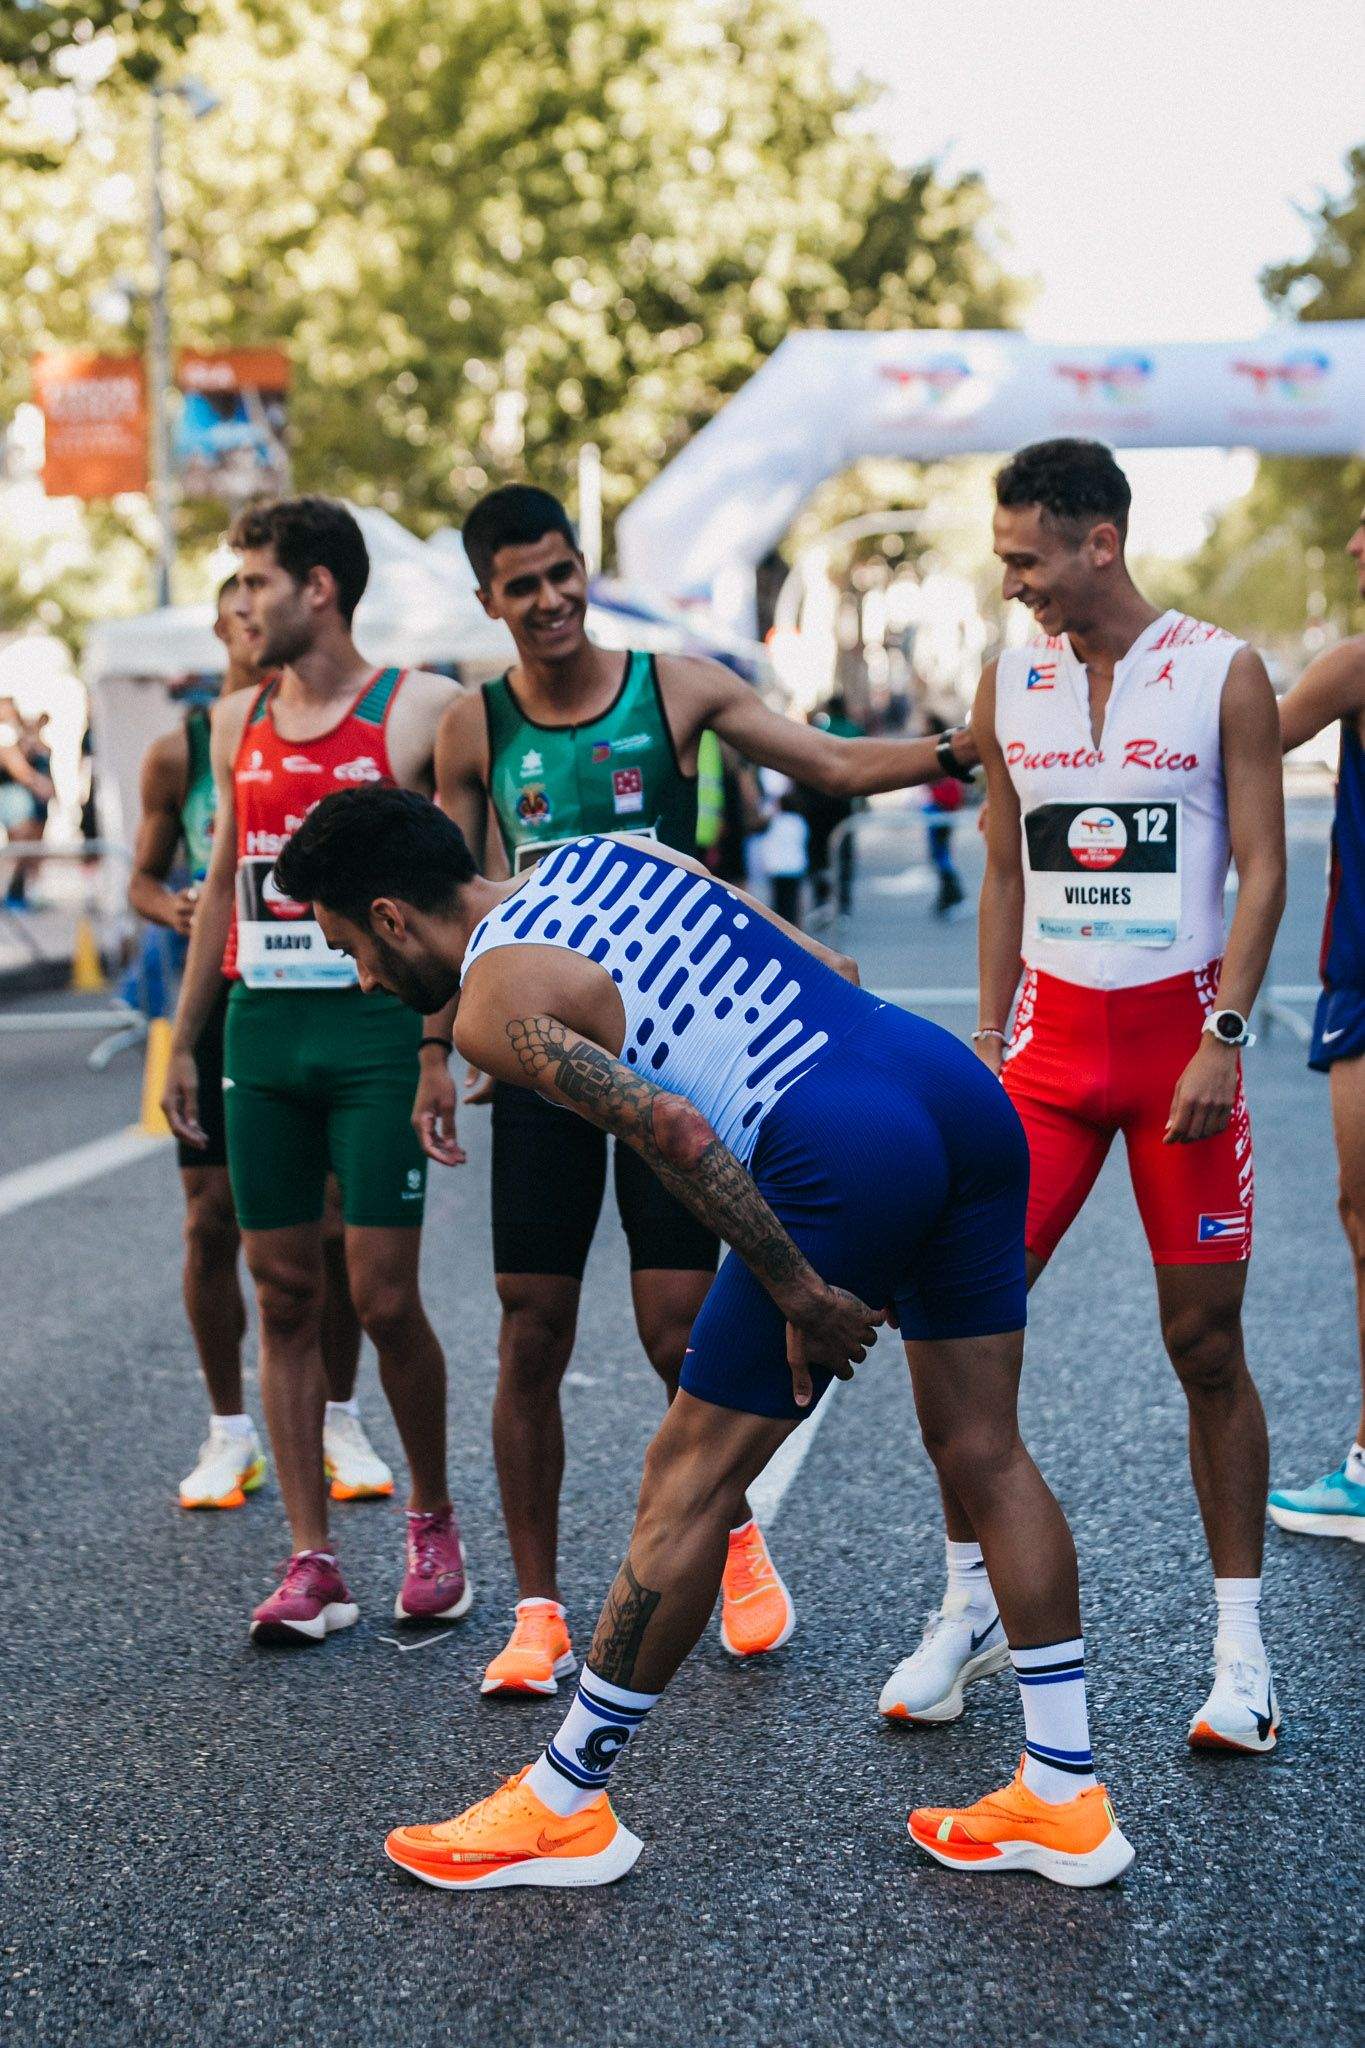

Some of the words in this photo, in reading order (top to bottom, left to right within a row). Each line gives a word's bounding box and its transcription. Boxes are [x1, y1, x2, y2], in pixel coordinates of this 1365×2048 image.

[1007, 741, 1104, 769] Puerto
[1122, 739, 1199, 771] Rico
[1132, 807, 1169, 843] 12
[1065, 886, 1131, 905] VILCHES
[265, 934, 312, 950] BRAVO
